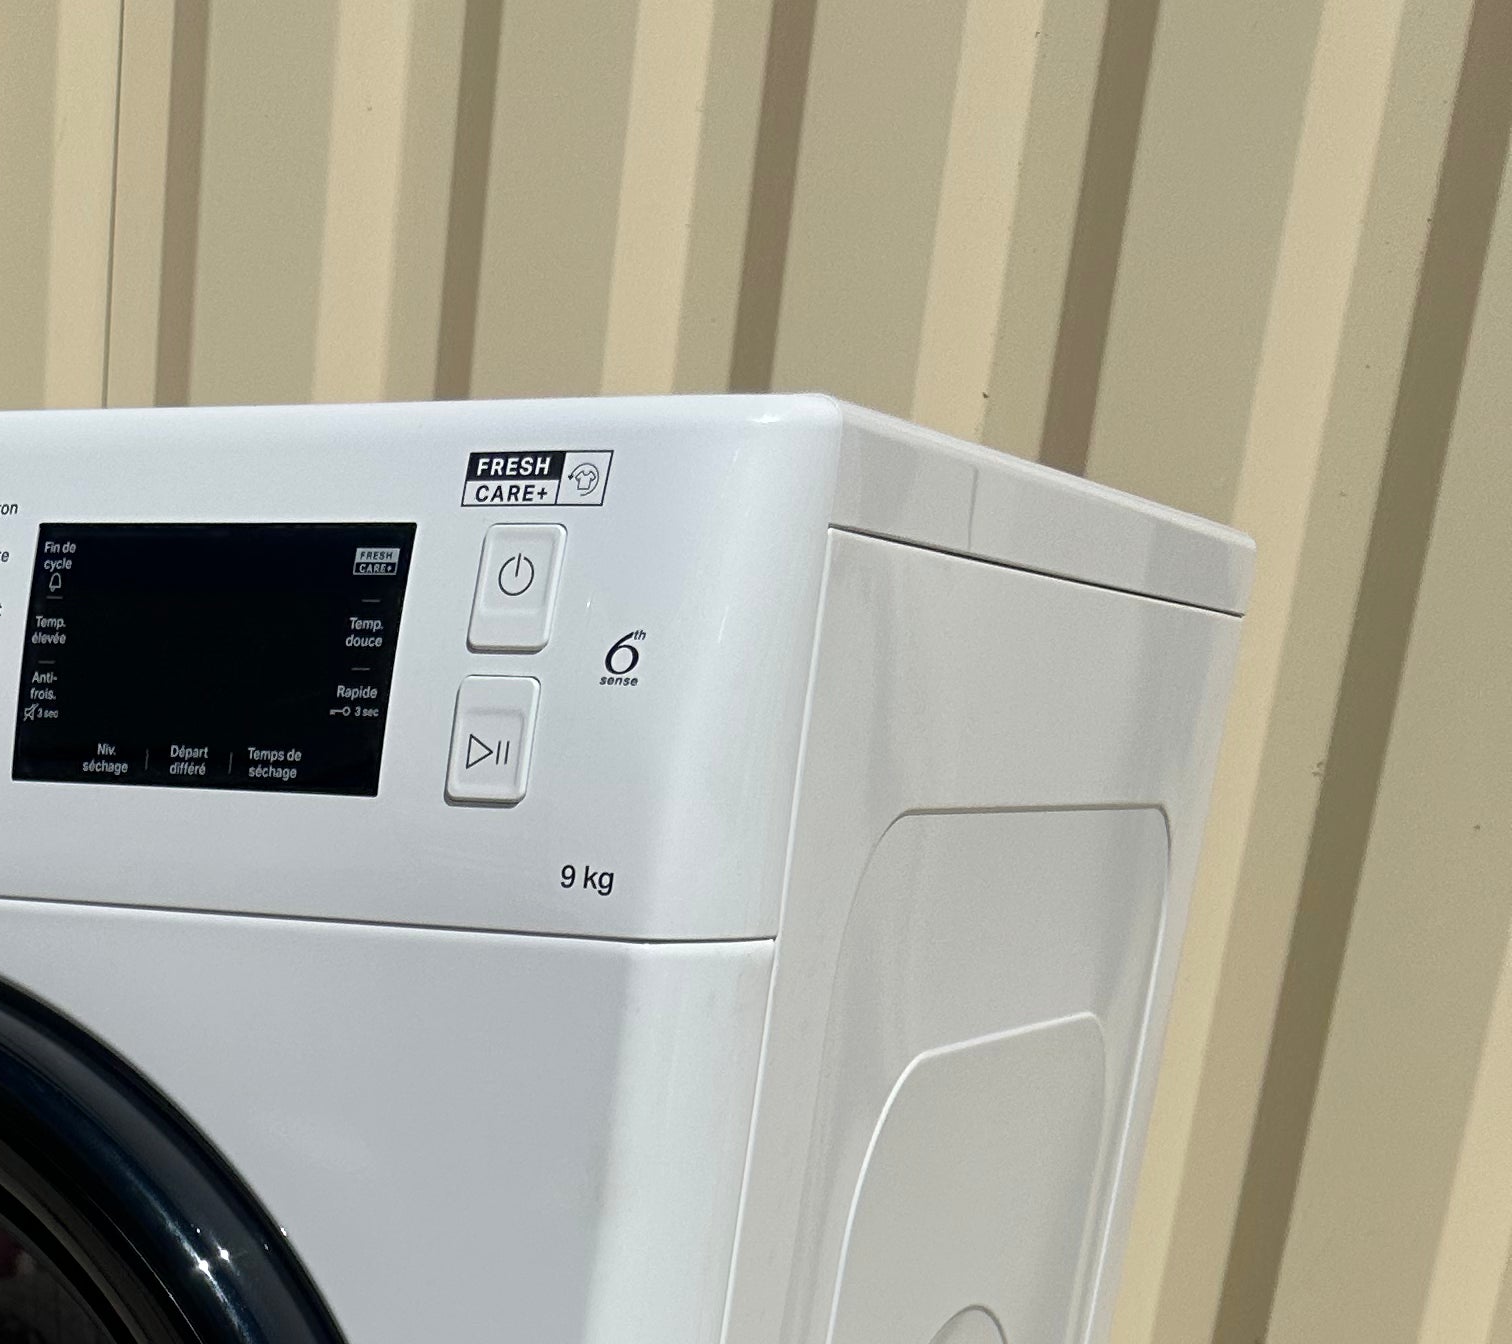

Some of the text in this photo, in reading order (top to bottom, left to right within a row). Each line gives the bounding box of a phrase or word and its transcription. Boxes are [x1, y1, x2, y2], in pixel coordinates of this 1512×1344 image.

[477, 457, 550, 475] FRESH
[475, 485, 548, 502] CARE+
[44, 542, 76, 553] Fin de
[360, 550, 393, 560] FRESH
[44, 558, 72, 570] cycle
[36, 617, 66, 629] Temp.
[350, 618, 384, 631] Temp.
[31, 632, 66, 644] élevée
[346, 635, 383, 647] douce
[32, 672, 57, 683] Anti-
[599, 676, 638, 687] sense
[30, 687, 56, 699] frois.
[337, 686, 378, 699] Rapide
[37, 708, 58, 718] 3 sec
[355, 706, 379, 716] 3 sec
[97, 744, 116, 755] Niv.
[170, 744, 208, 760] Départ
[248, 747, 302, 762] Temps de
[83, 759, 128, 774] séchage
[169, 762, 206, 775] différé
[249, 765, 297, 780] séchage
[561, 865, 614, 896] 9 kg
